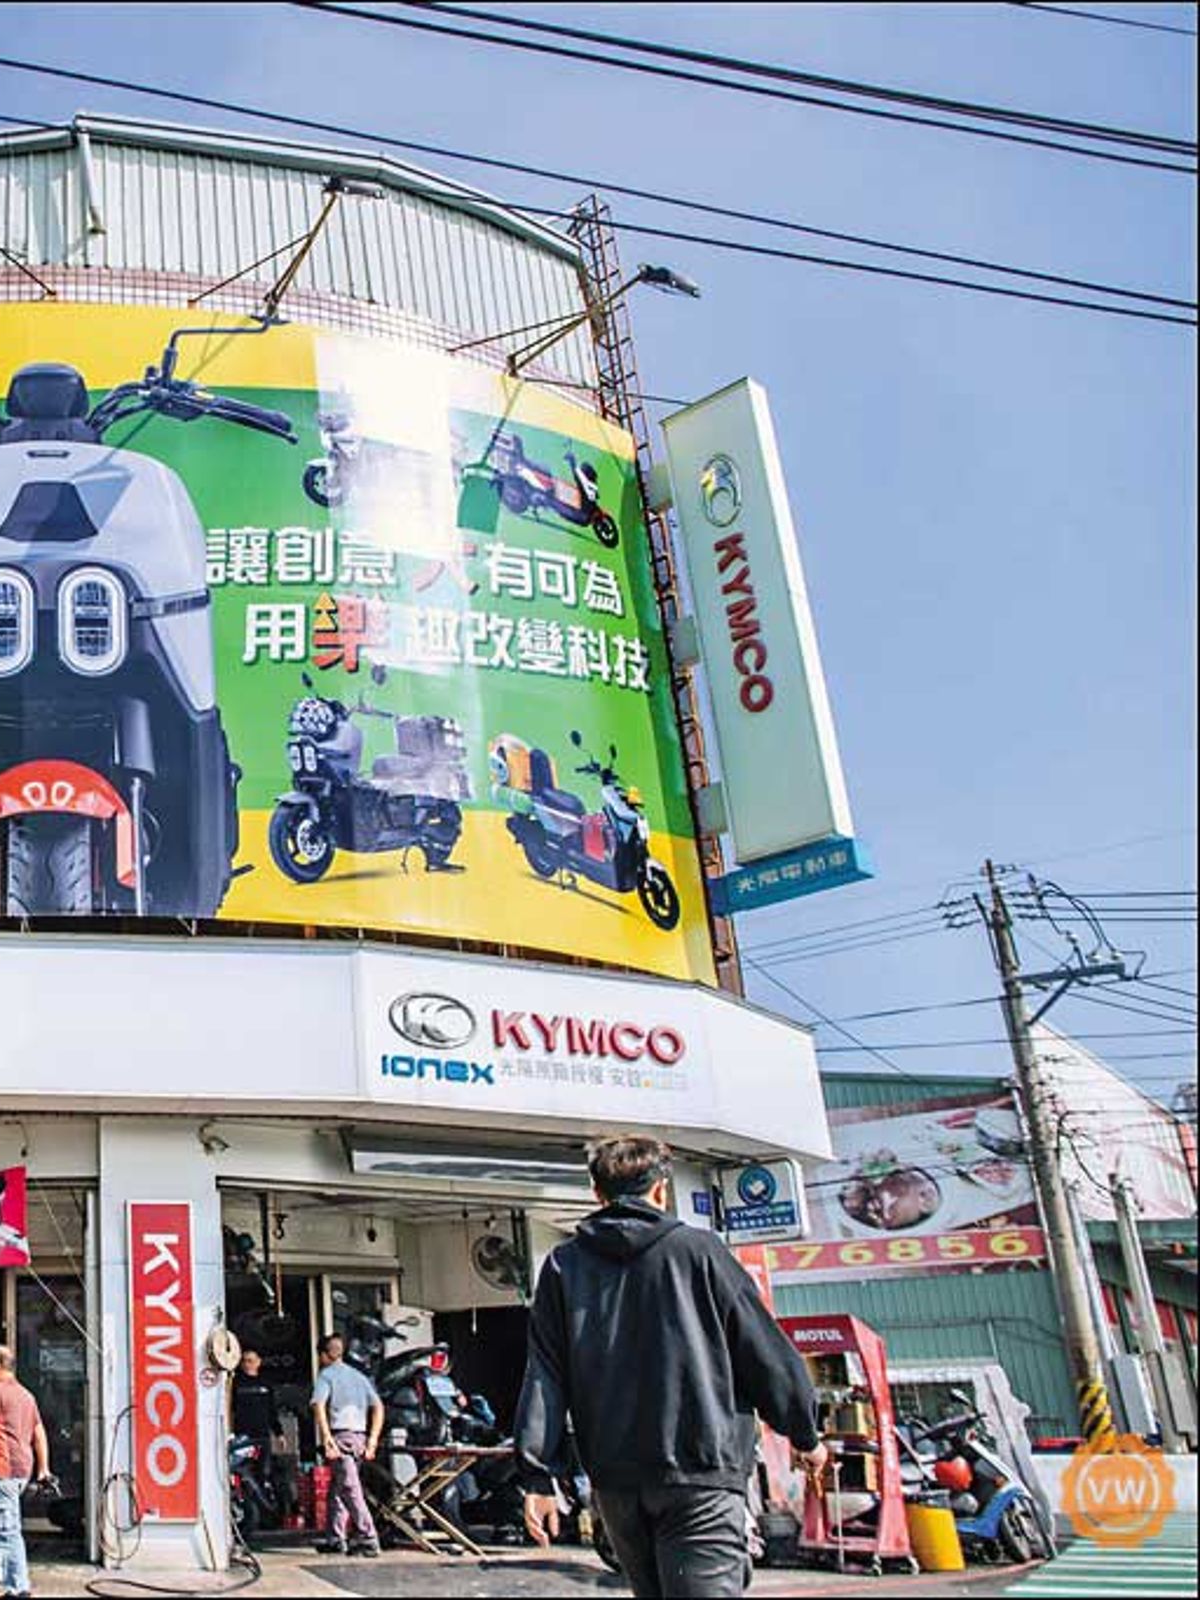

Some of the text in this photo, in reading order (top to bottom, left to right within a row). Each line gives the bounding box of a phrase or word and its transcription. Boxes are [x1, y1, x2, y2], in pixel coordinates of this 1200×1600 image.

[241, 592, 652, 693] 用樂趣改變科技
[714, 531, 775, 713] KYMCO
[491, 1009, 687, 1067] KYMCO
[142, 1232, 188, 1487] KYMCO
[793, 1327, 845, 1343] MOTUL
